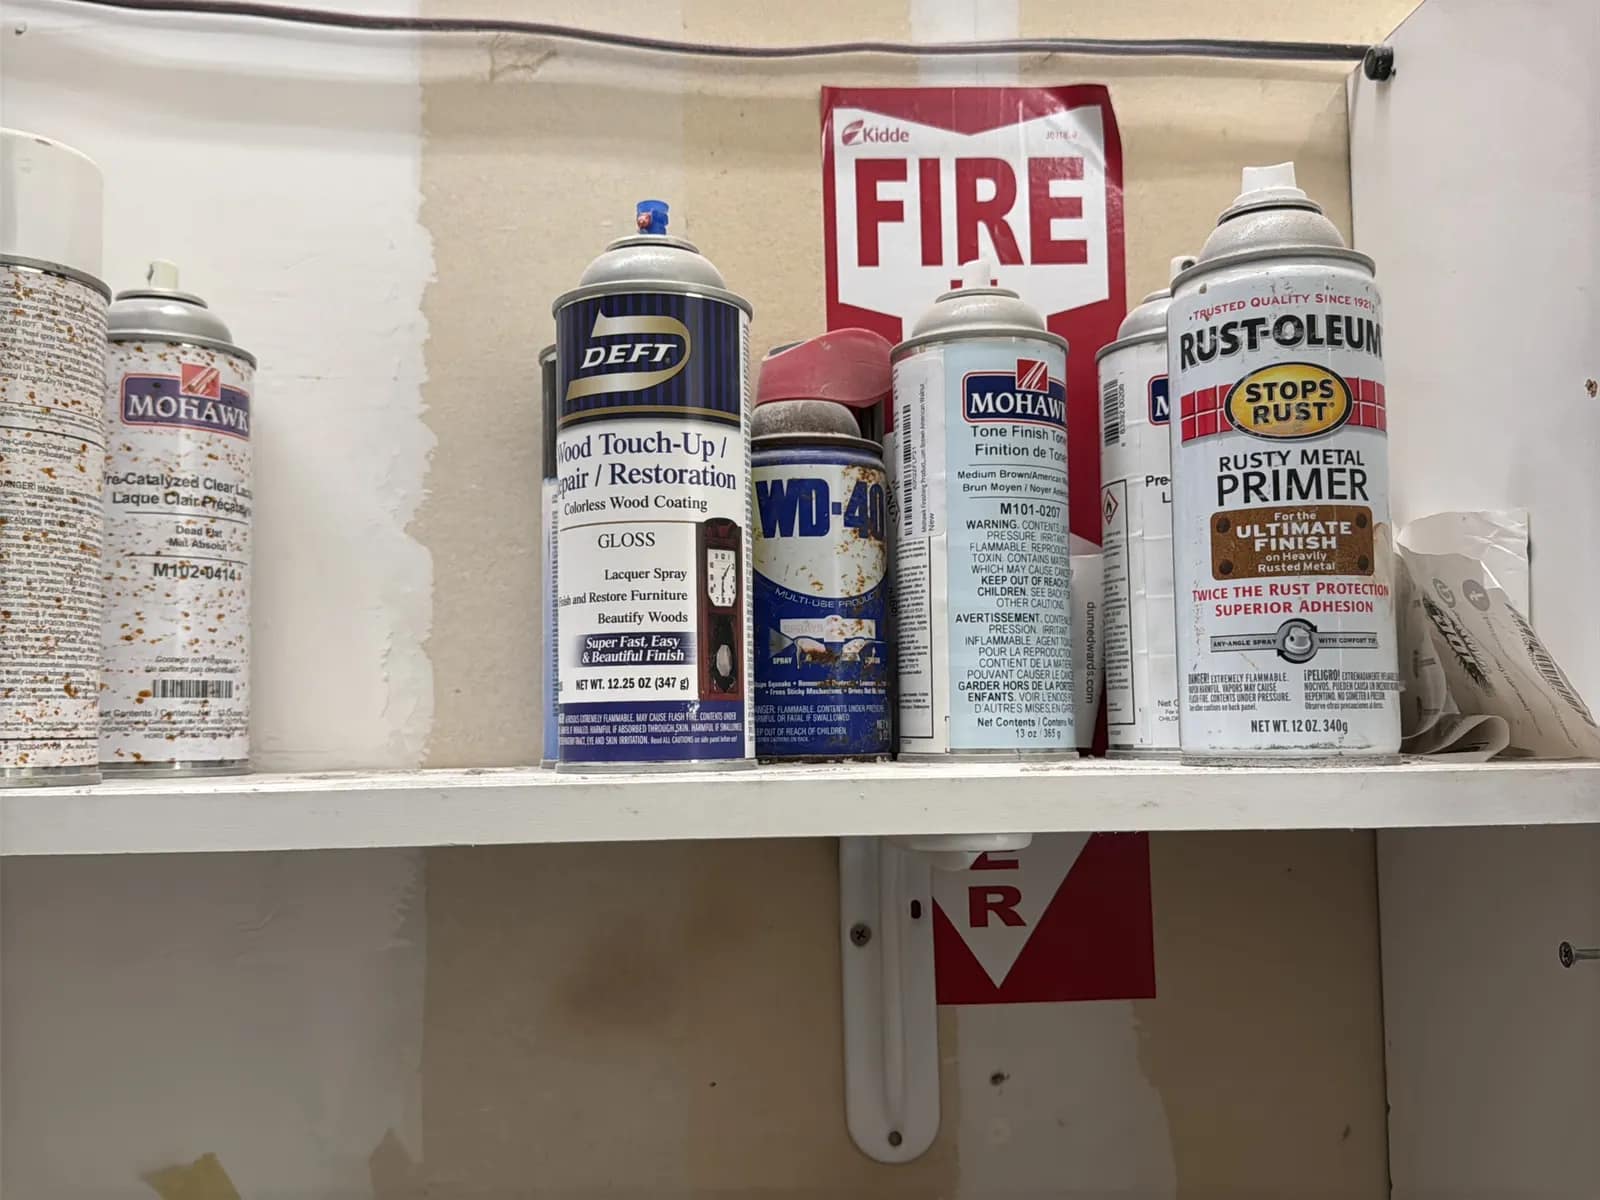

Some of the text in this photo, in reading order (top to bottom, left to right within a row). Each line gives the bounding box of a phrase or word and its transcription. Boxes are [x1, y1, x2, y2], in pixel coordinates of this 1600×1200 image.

[863, 127, 909, 143] Kidde
[855, 156, 1088, 267] FIRE
[1193, 301, 1247, 321] TRUSTED
[1250, 293, 1311, 308] QUALITY
[1315, 293, 1350, 305] SINCE
[1180, 313, 1383, 371] RUST-OLEUM
[580, 343, 677, 369] DEFT
[1245, 378, 1335, 402] STOPS
[128, 393, 249, 432] MOHAWK
[1253, 402, 1328, 425] RUST
[971, 426, 1008, 438] Tone
[1011, 427, 1049, 441] Finish
[598, 431, 716, 463] Touch-Up
[975, 444, 1047, 459] Finition de
[1219, 449, 1365, 472] RUSTY METAL
[608, 462, 737, 490] Restoration
[957, 471, 997, 480] Medium
[203, 477, 234, 496] Clear
[963, 484, 1052, 495] Brun Moyen Noyer
[1217, 467, 1369, 507] PRIMER
[112, 491, 198, 508] Laque Clair
[564, 495, 708, 516] Colorless Wood Coating
[755, 478, 885, 541] WD-40
[1000, 502, 1061, 519] M101-0207
[1274, 511, 1317, 522] For the
[175, 525, 203, 536] Dead
[966, 519, 1020, 530] WARNING.
[1236, 521, 1352, 539] ULTIMATE
[597, 532, 656, 549] GLOSS
[1254, 536, 1337, 552] FINISH
[1007, 554, 1050, 565] CONTAINS
[1266, 551, 1327, 562] on Heavily
[153, 562, 237, 582] M102-0414
[605, 567, 687, 582] Lacquer Spray
[971, 564, 1054, 575] WHICH MAY CAUSE
[1258, 562, 1336, 573] Rusted Metal
[981, 575, 1043, 586] KEEP OUT OF
[572, 589, 688, 605] and Restore Furniture
[774, 588, 835, 609] MULTI-USE
[977, 586, 1046, 597] CHILDREN. SEE
[1192, 582, 1390, 601] TWICE THE RUST PROTECTION
[996, 598, 1029, 608] OTHER
[1215, 600, 1374, 617] SUPERIOR ADHESION
[598, 611, 688, 626] Beautify Woods
[955, 613, 1043, 624] AVERTISSEMENT.
[586, 635, 680, 650] Super Fast, Easy
[1213, 639, 1251, 648] ANY-ANGLE
[1253, 638, 1277, 646] SPRAY
[1339, 637, 1367, 645] COMFORT
[582, 650, 685, 664] & Beautiful Finish
[979, 647, 1021, 657] POUR LA
[1085, 601, 1096, 704] dunnedwards.com
[979, 658, 1042, 668] CONTIENT DE
[967, 670, 1051, 680] POUVANT CAUSER
[1211, 673, 1244, 683] EXTREMELY
[1246, 673, 1289, 682] FLAMMABLE.
[576, 677, 689, 691] NET WT. 12.25 OZ (347 g)
[958, 681, 1001, 691] GARDER
[1003, 681, 1030, 691] HORS
[1032, 681, 1043, 691] DE
[1257, 683, 1277, 692] CAUSE
[1019, 692, 1040, 702] VOIR
[1258, 692, 1291, 701] PRESSURE.
[974, 703, 1023, 713] D'AUTRES
[603, 713, 635, 723] FLAMMABLE.
[650, 712, 667, 722] CAUSE
[668, 712, 685, 721] FLASH
[978, 717, 1036, 727] Net Contents
[618, 724, 645, 734] ABSORBED
[1015, 729, 1025, 737] 13
[1251, 719, 1348, 735] NET WT. 12 OZ. 340g
